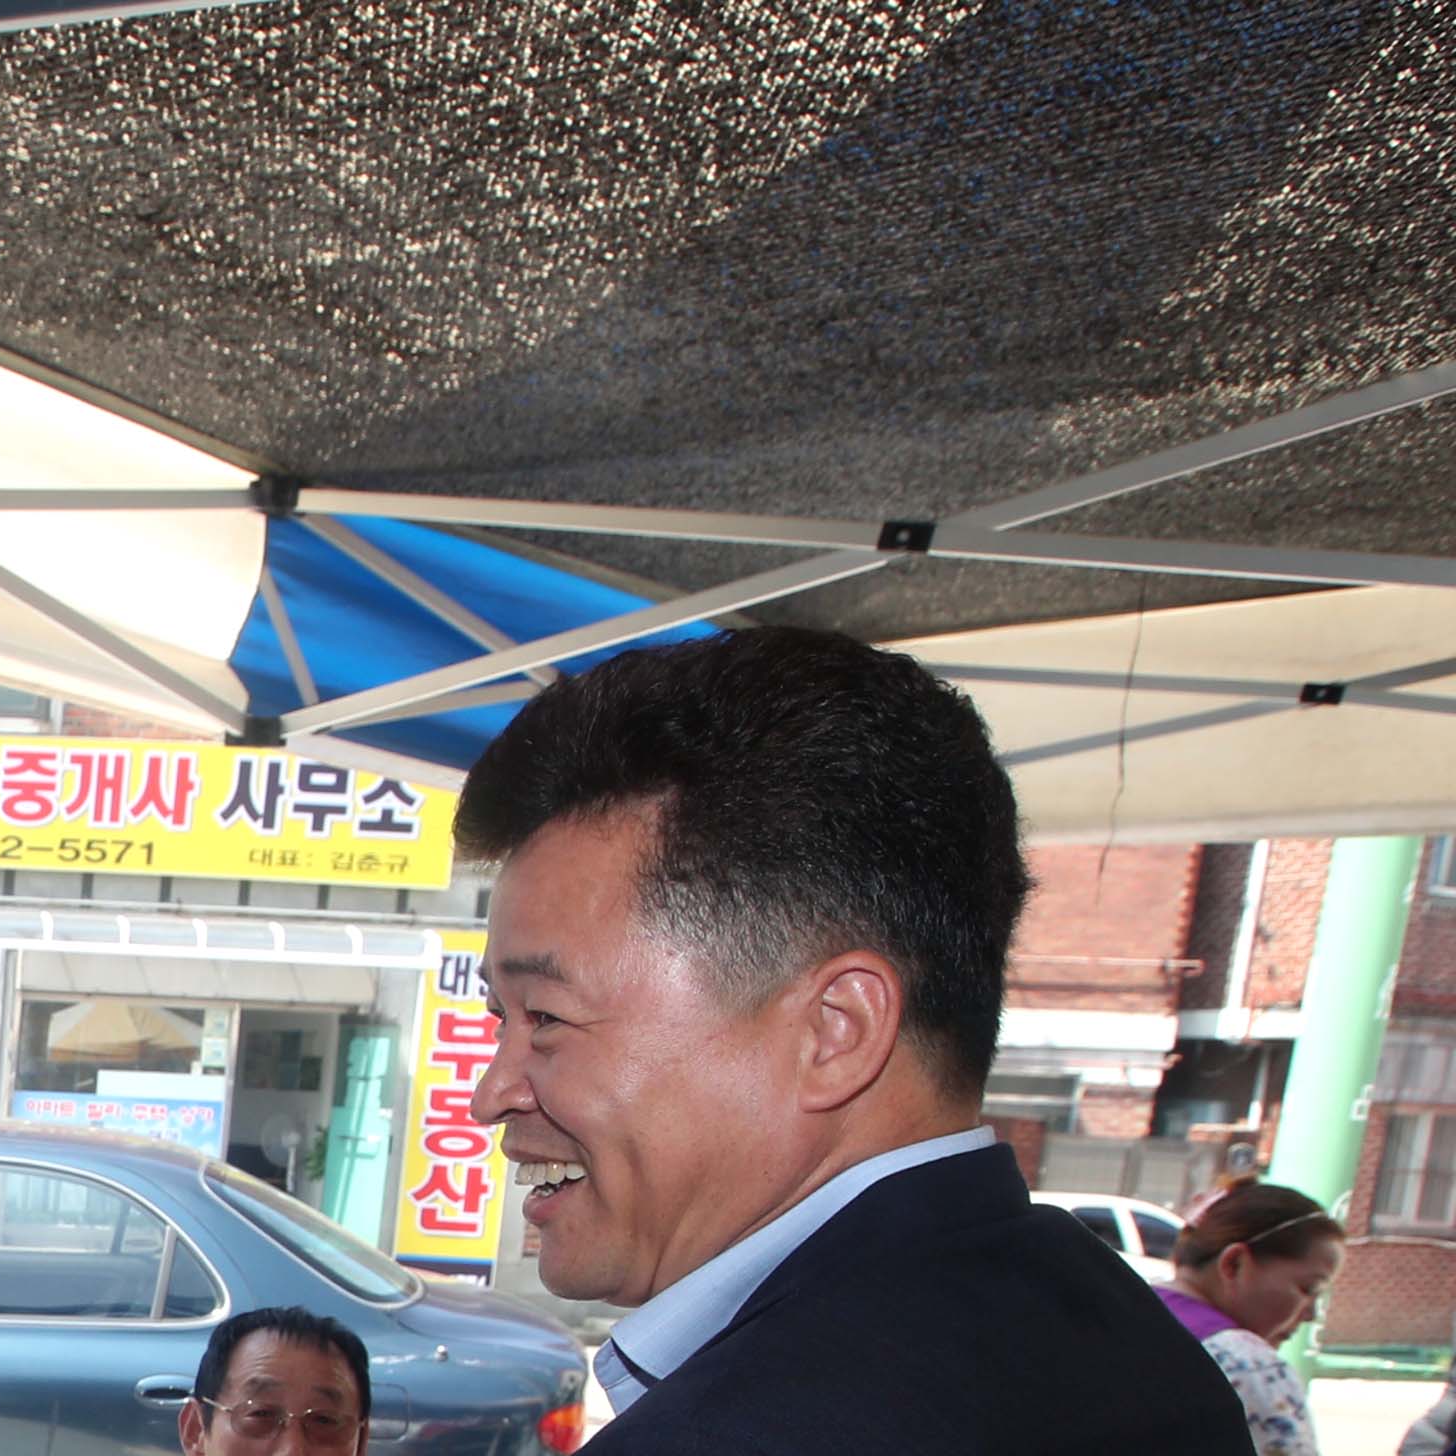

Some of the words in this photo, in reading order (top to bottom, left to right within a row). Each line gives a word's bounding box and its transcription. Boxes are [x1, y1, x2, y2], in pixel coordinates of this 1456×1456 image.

[219, 755, 422, 836] 사무소
[248, 848, 314, 868] 대표:
[439, 953, 488, 997] 대
[410, 1011, 502, 1233] 부동산
